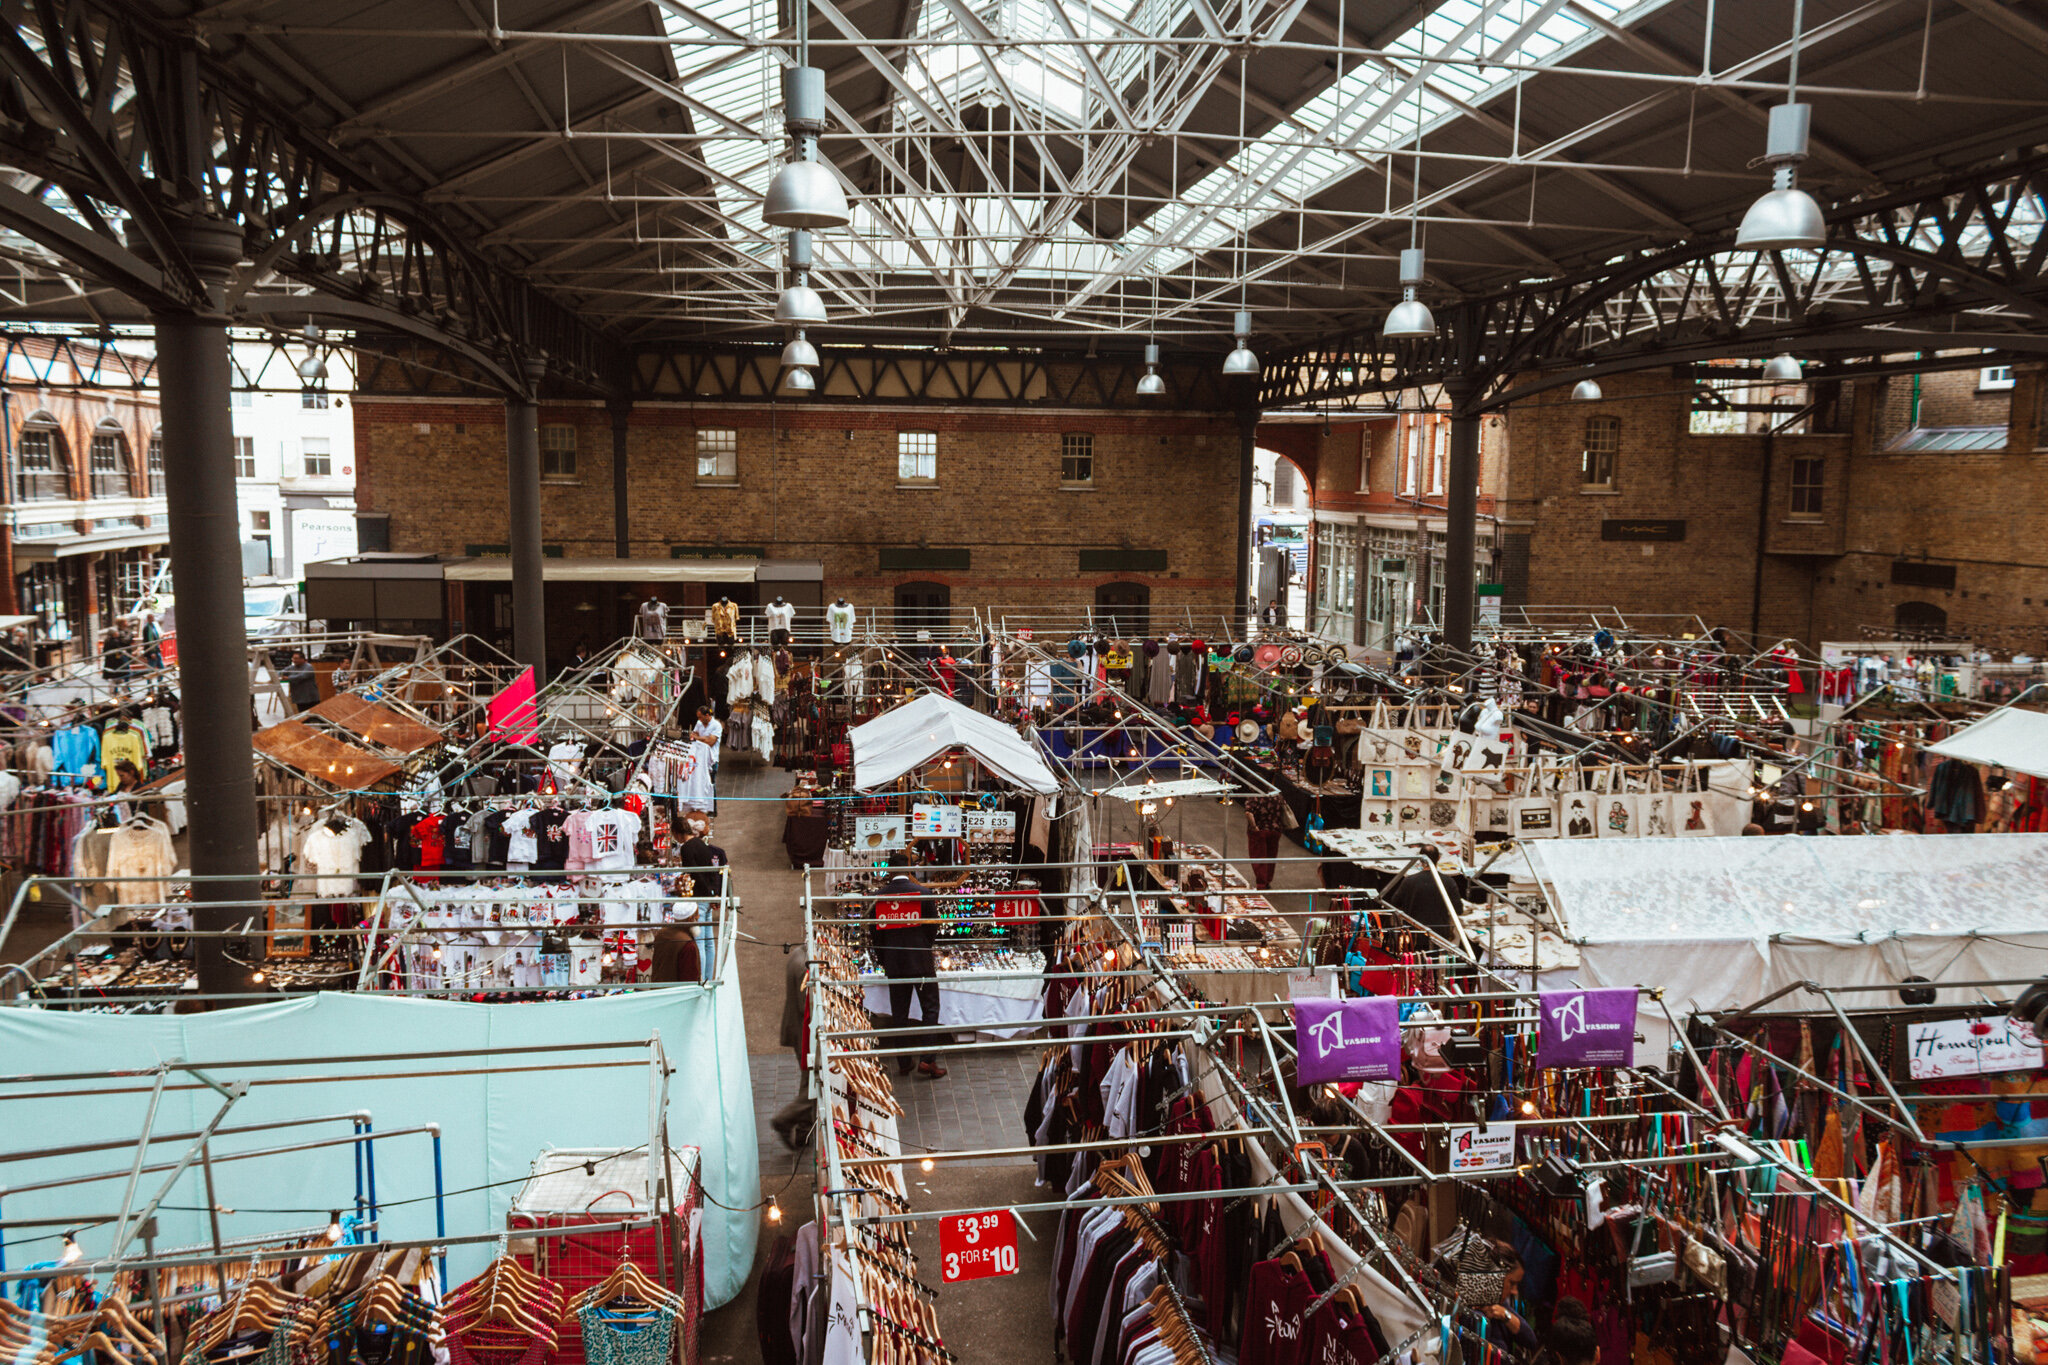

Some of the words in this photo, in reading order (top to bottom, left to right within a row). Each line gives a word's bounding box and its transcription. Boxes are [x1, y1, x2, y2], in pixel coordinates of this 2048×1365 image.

[302, 522, 352, 532] Pearsons
[968, 817, 985, 825] £25
[991, 818, 1008, 826] £35
[1002, 899, 1032, 917] £10
[958, 1214, 999, 1244] £3.99
[945, 1252, 960, 1279] 3
[961, 1249, 980, 1264] FOR
[982, 1245, 1015, 1272] £10
